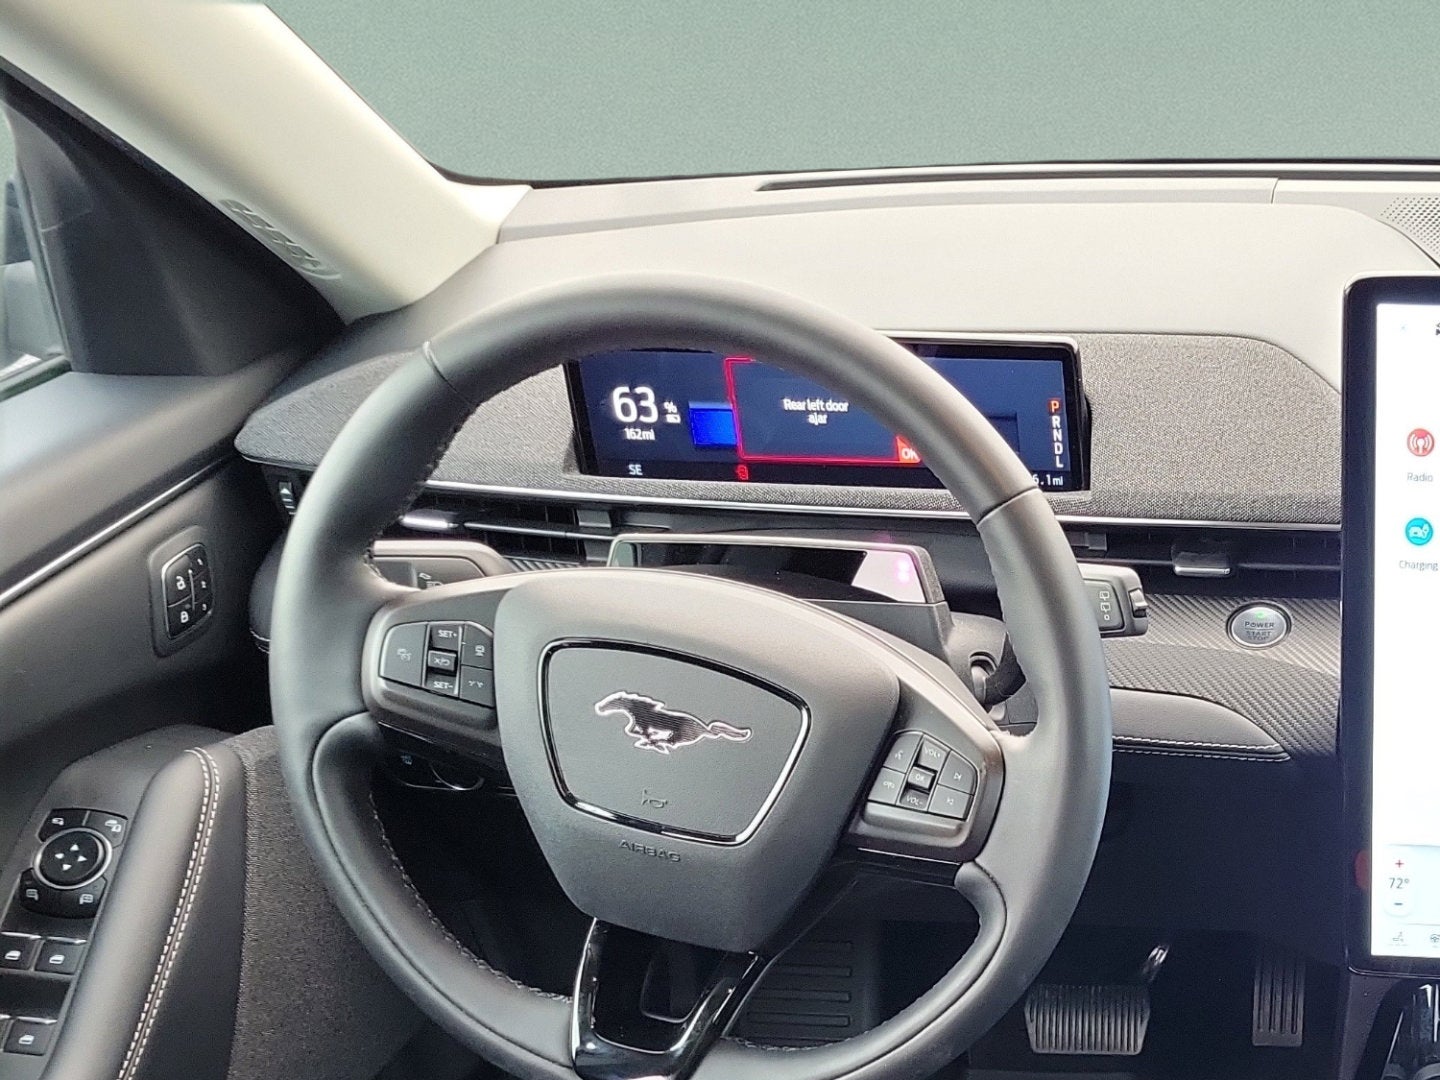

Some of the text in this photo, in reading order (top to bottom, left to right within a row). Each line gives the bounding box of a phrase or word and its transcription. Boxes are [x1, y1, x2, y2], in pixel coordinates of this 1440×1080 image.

[612, 386, 659, 423] 63
[782, 398, 849, 412] Rear left door
[807, 412, 828, 426] ajar
[623, 427, 656, 441] 162mi
[628, 464, 643, 476] SE
[1407, 472, 1434, 483] Radio
[1398, 560, 1439, 573] Charging
[438, 630, 457, 638] SET+
[619, 839, 681, 862] AIRBAG
[1388, 877, 1410, 889] 72°
